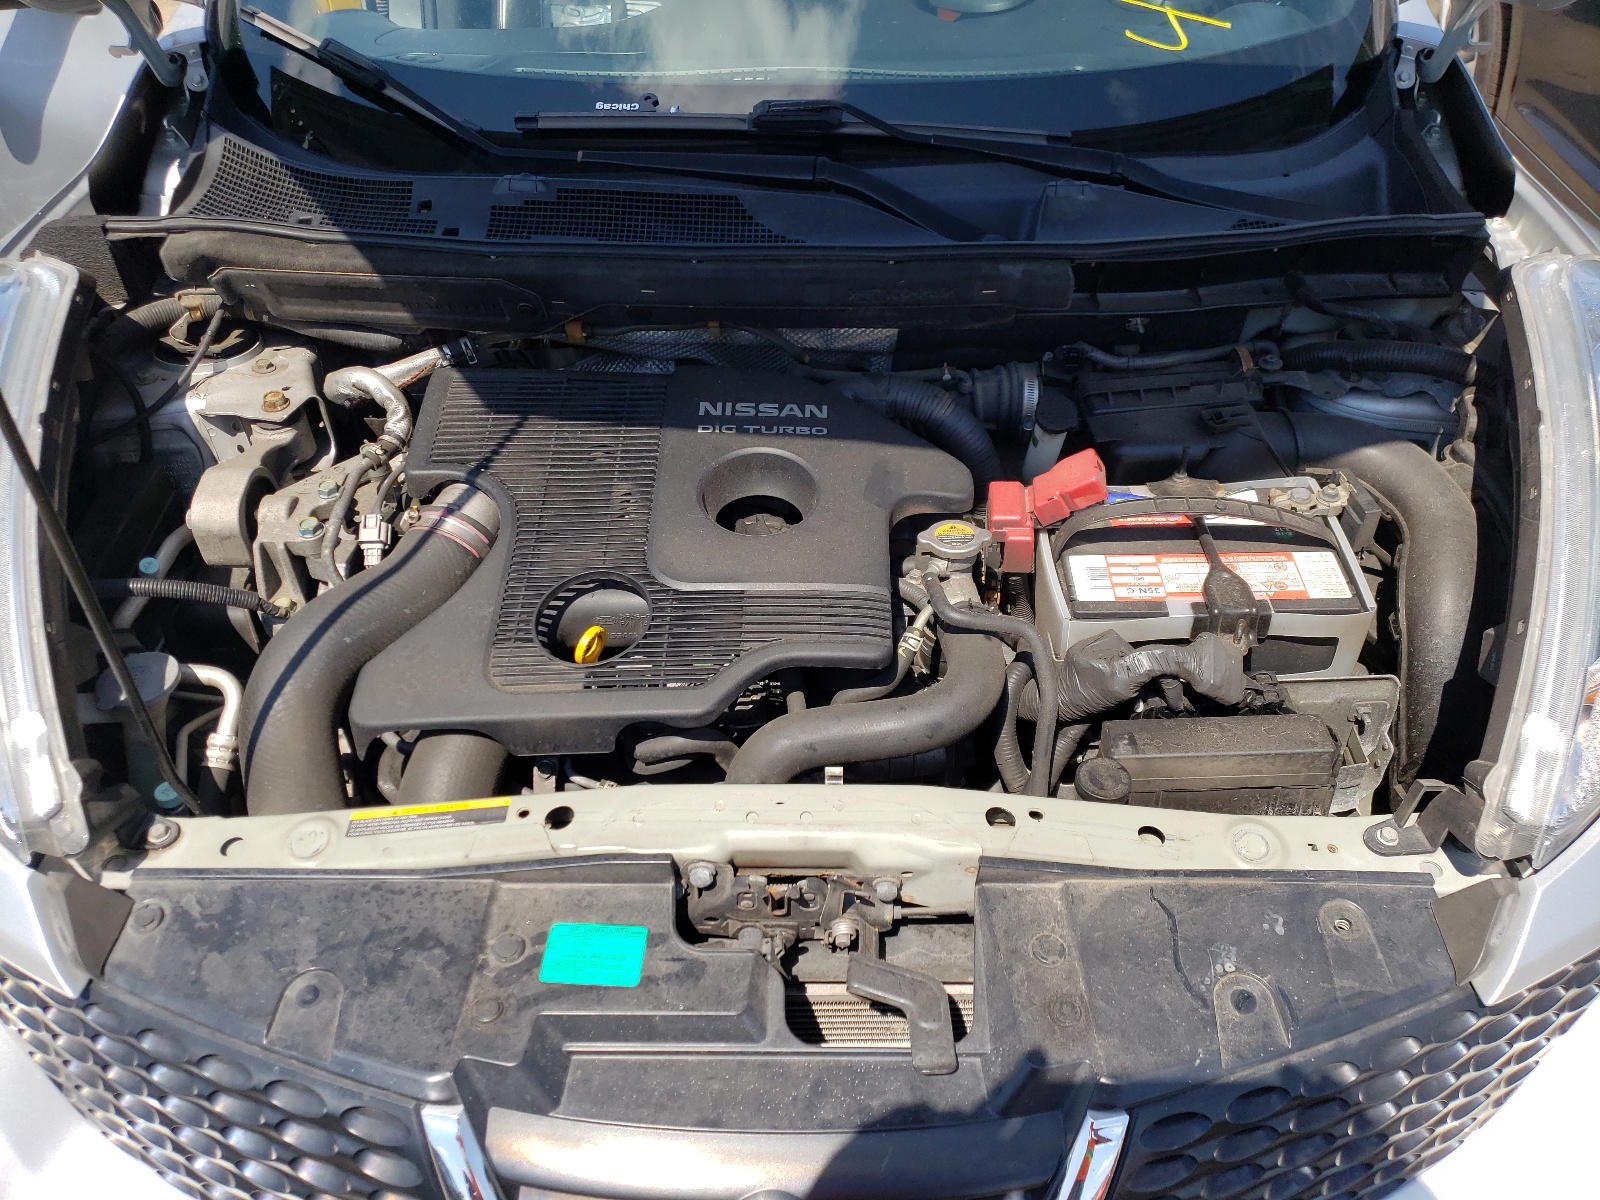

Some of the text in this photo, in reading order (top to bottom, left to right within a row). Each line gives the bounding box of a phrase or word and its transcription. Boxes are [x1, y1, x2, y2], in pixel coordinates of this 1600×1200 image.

[698, 401, 828, 419] NISSAN
[697, 424, 828, 435] DIG TURBO
[1138, 587, 1161, 595] 35N
